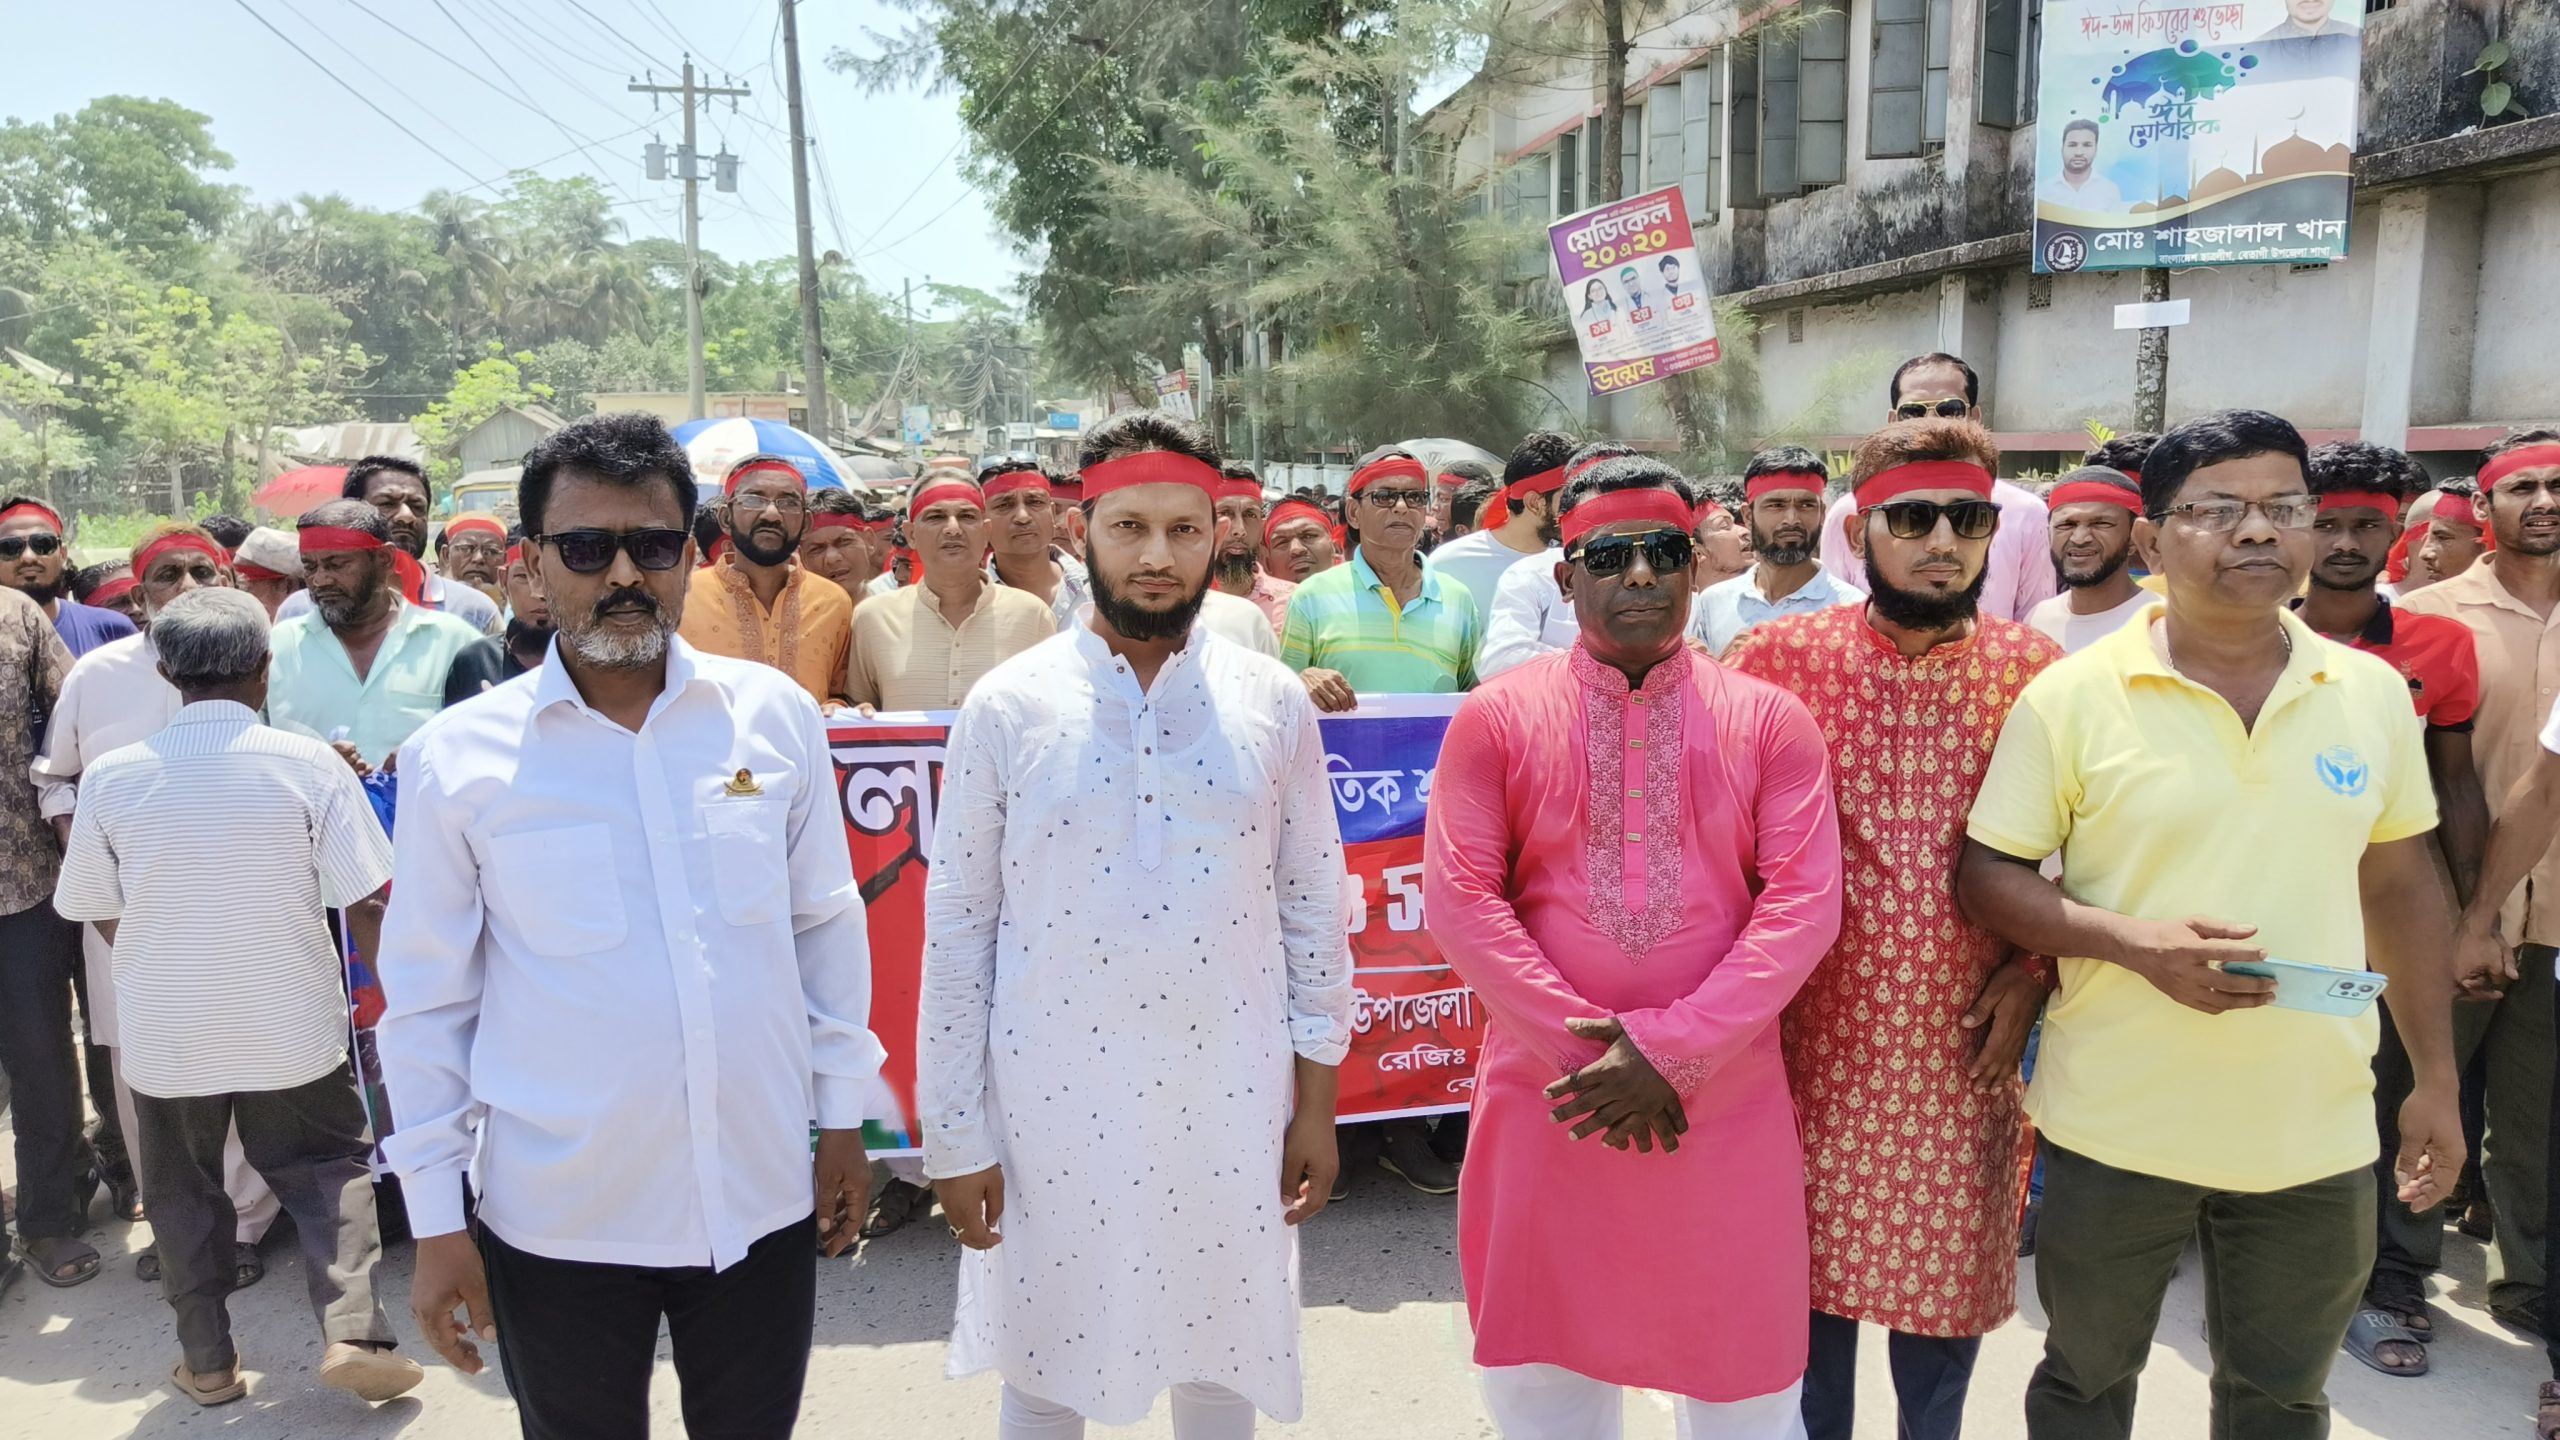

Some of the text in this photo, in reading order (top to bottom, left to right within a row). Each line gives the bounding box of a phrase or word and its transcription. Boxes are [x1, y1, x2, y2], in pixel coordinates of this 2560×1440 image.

[2137, 0, 2190, 44] ফিতরের
[2193, 3, 2244, 40] শুভেচ্ছা
[2148, 96, 2197, 122] ঈদ
[2129, 119, 2220, 148] মোবারক
[1567, 202, 1672, 253] মেডিকেল
[2094, 218, 2348, 251] মোঃ শাহজালাল খান
[1581, 245, 1617, 269] ২০
[1632, 229, 1668, 253] ২০
[1590, 357, 1656, 391] উন্মেষ
[1353, 984, 1475, 1034] উপজেলা
[1378, 1043, 1466, 1072] রেজিঃ
